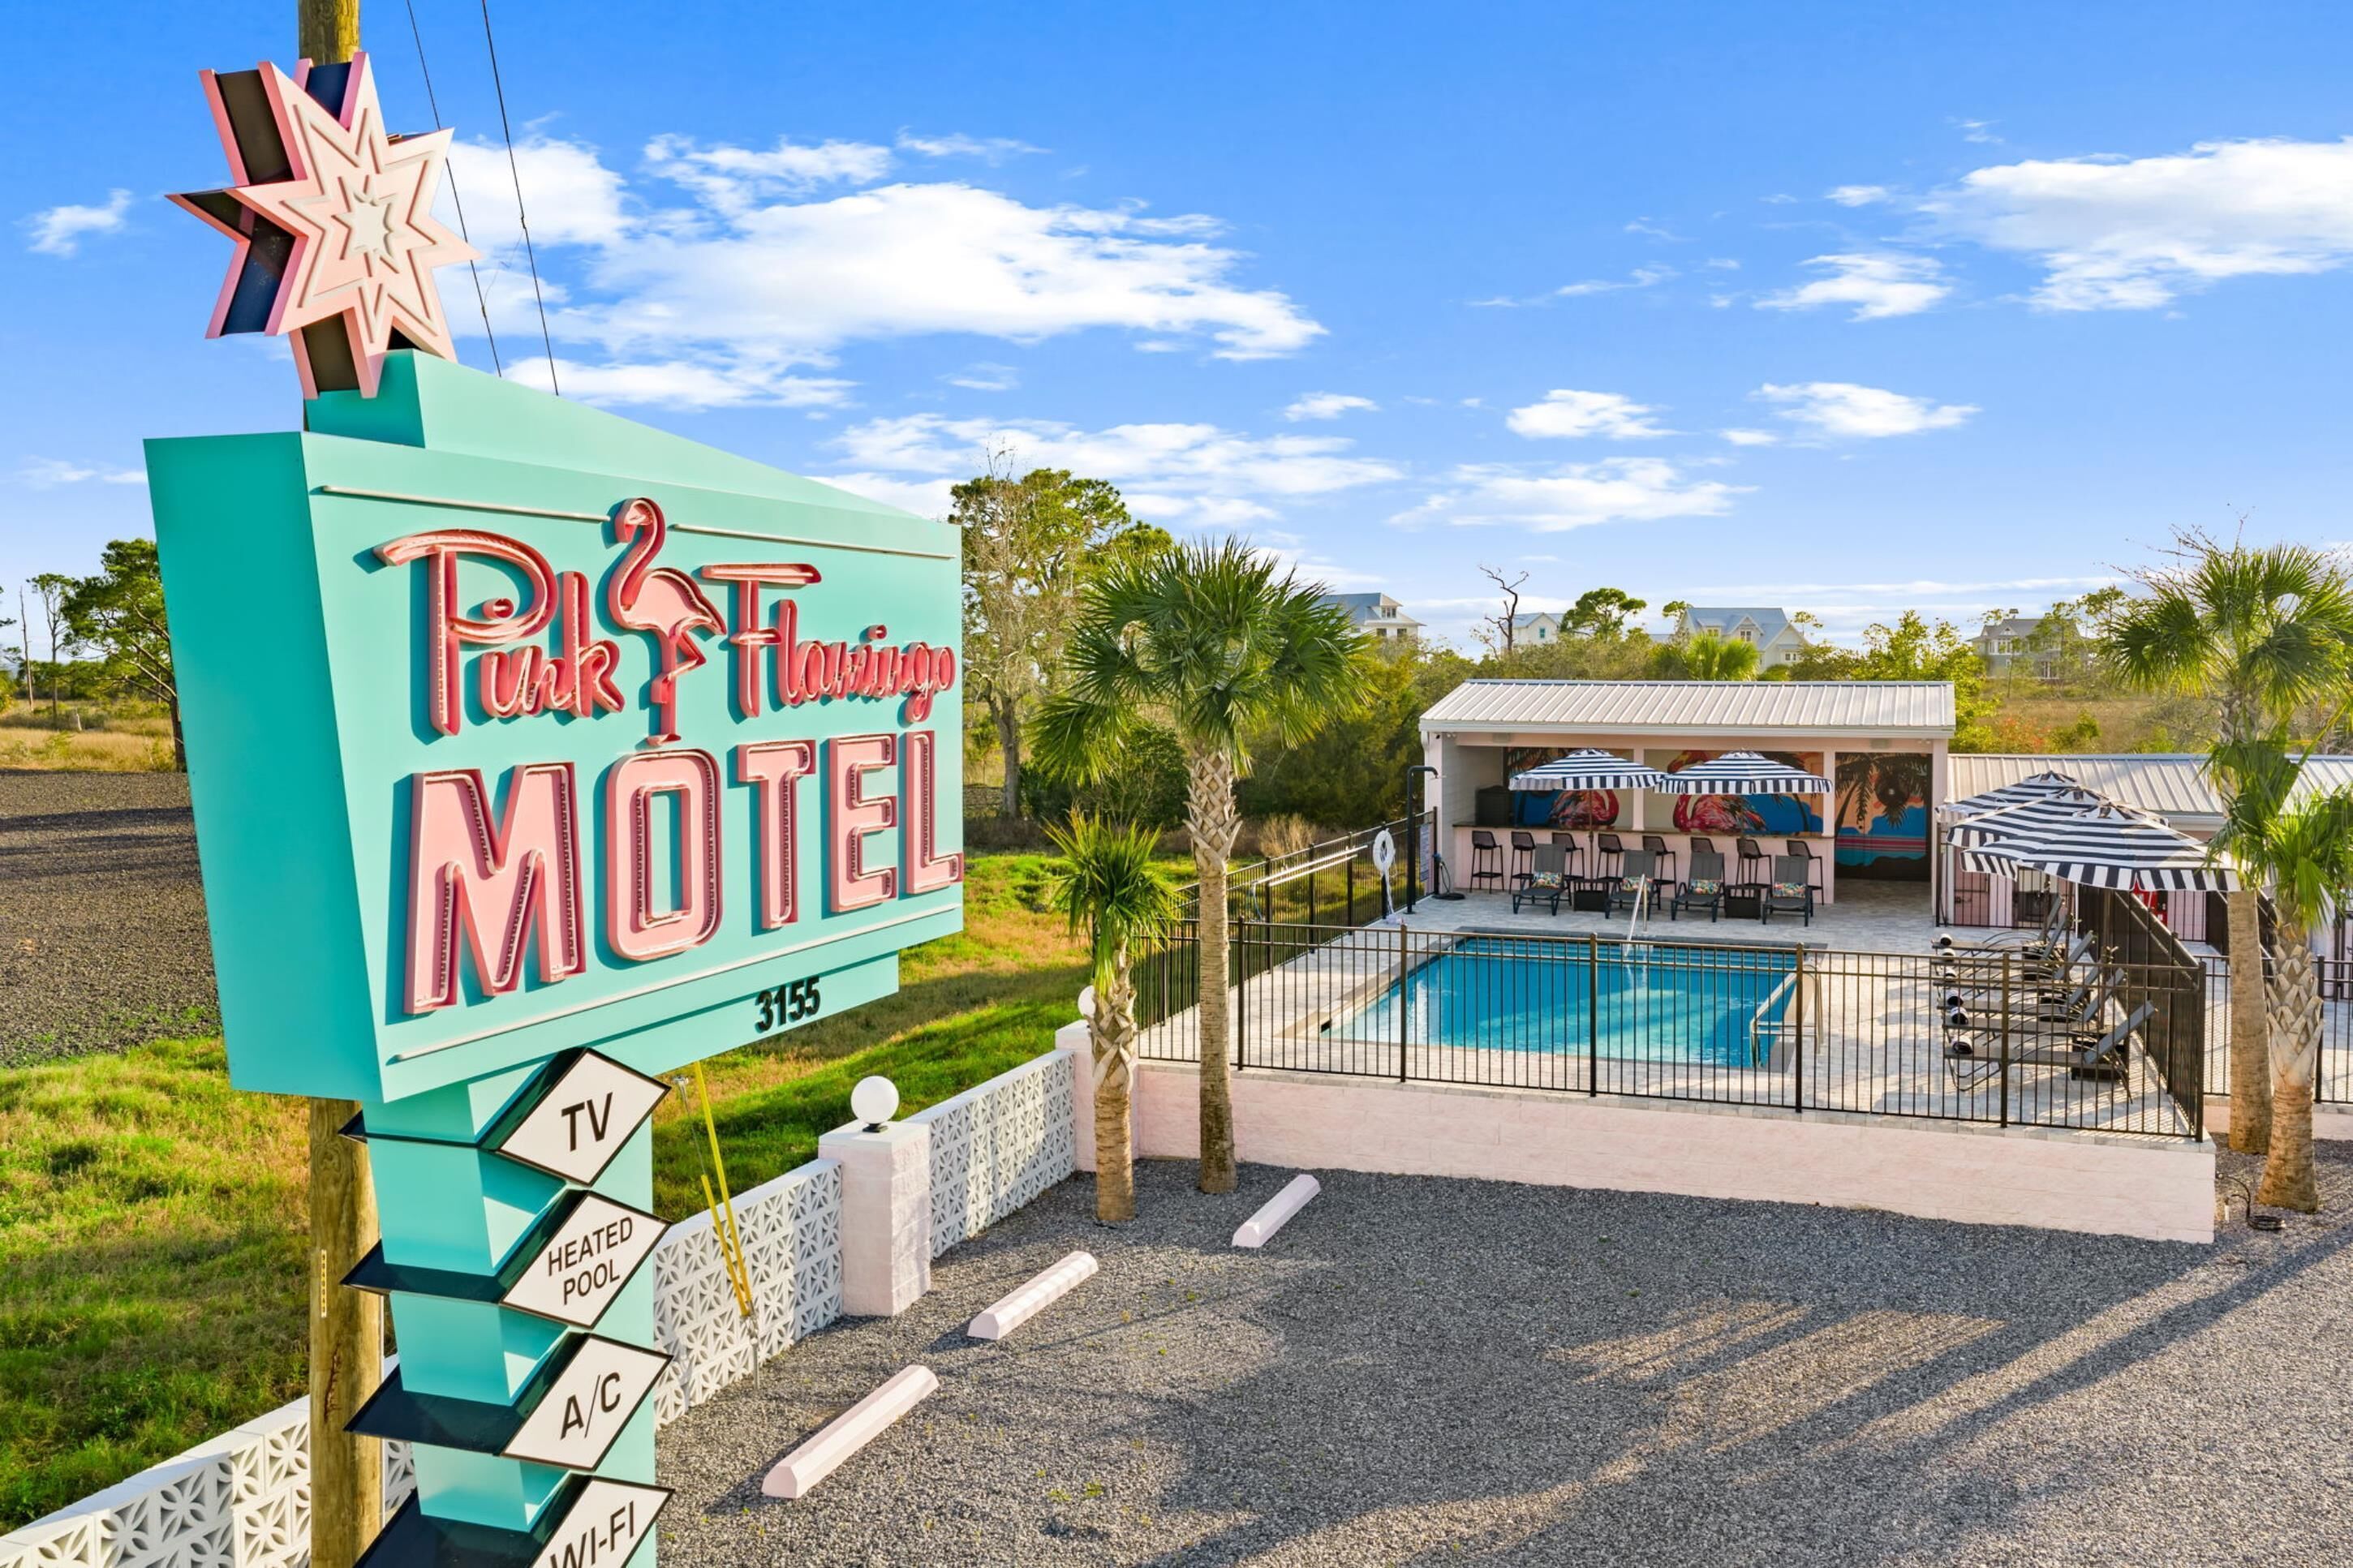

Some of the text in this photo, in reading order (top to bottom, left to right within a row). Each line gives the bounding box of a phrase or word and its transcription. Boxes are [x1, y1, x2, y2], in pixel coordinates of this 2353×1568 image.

[373, 529, 956, 737] Pink Flamingo
[404, 730, 963, 1015] MOTEL
[755, 974, 820, 1033] 3155
[561, 1092, 613, 1152] TV
[548, 1217, 633, 1277] HEATED
[564, 1259, 620, 1306] POOL
[561, 1372, 621, 1441] A/C
[550, 1501, 634, 1568] WI-FI
